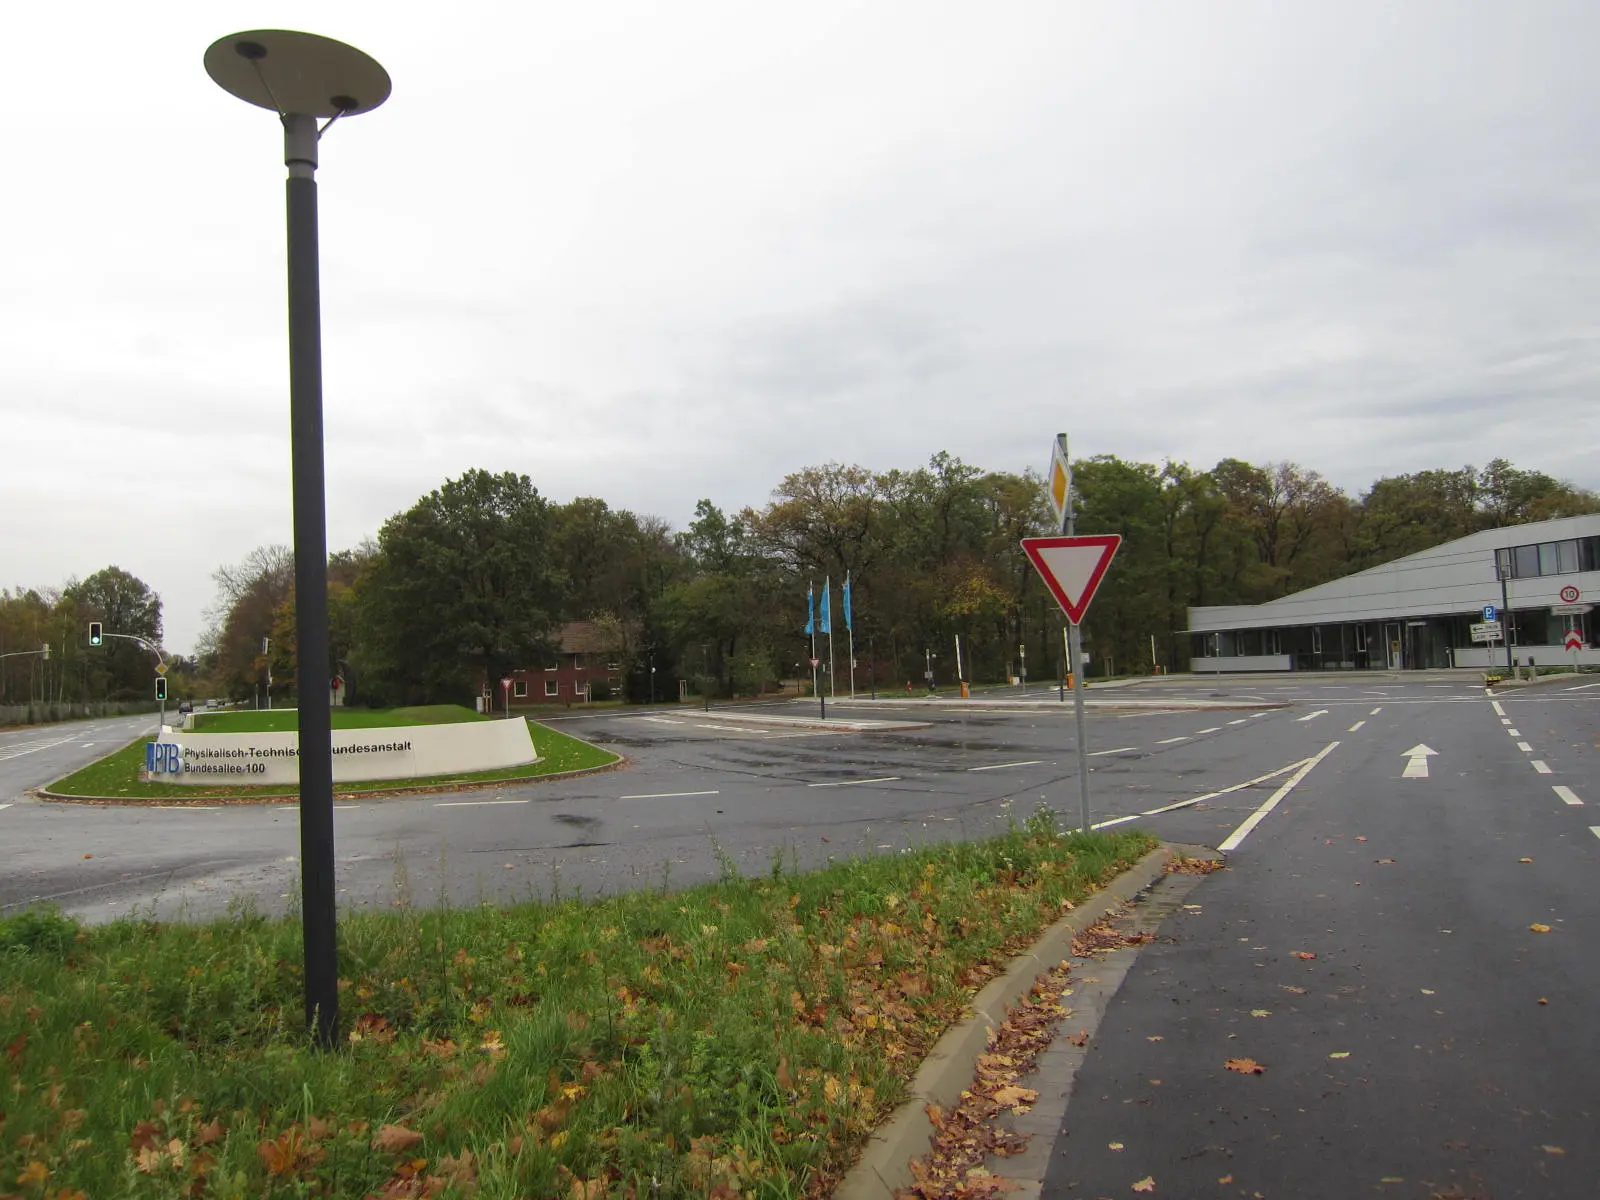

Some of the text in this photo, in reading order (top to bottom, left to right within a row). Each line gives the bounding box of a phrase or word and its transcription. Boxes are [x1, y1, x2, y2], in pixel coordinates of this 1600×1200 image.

[1485, 607, 1492, 618] P
[332, 741, 412, 755] undesanstalt
[155, 743, 180, 773] PTB
[184, 763, 266, 773] Bundesallee 100
